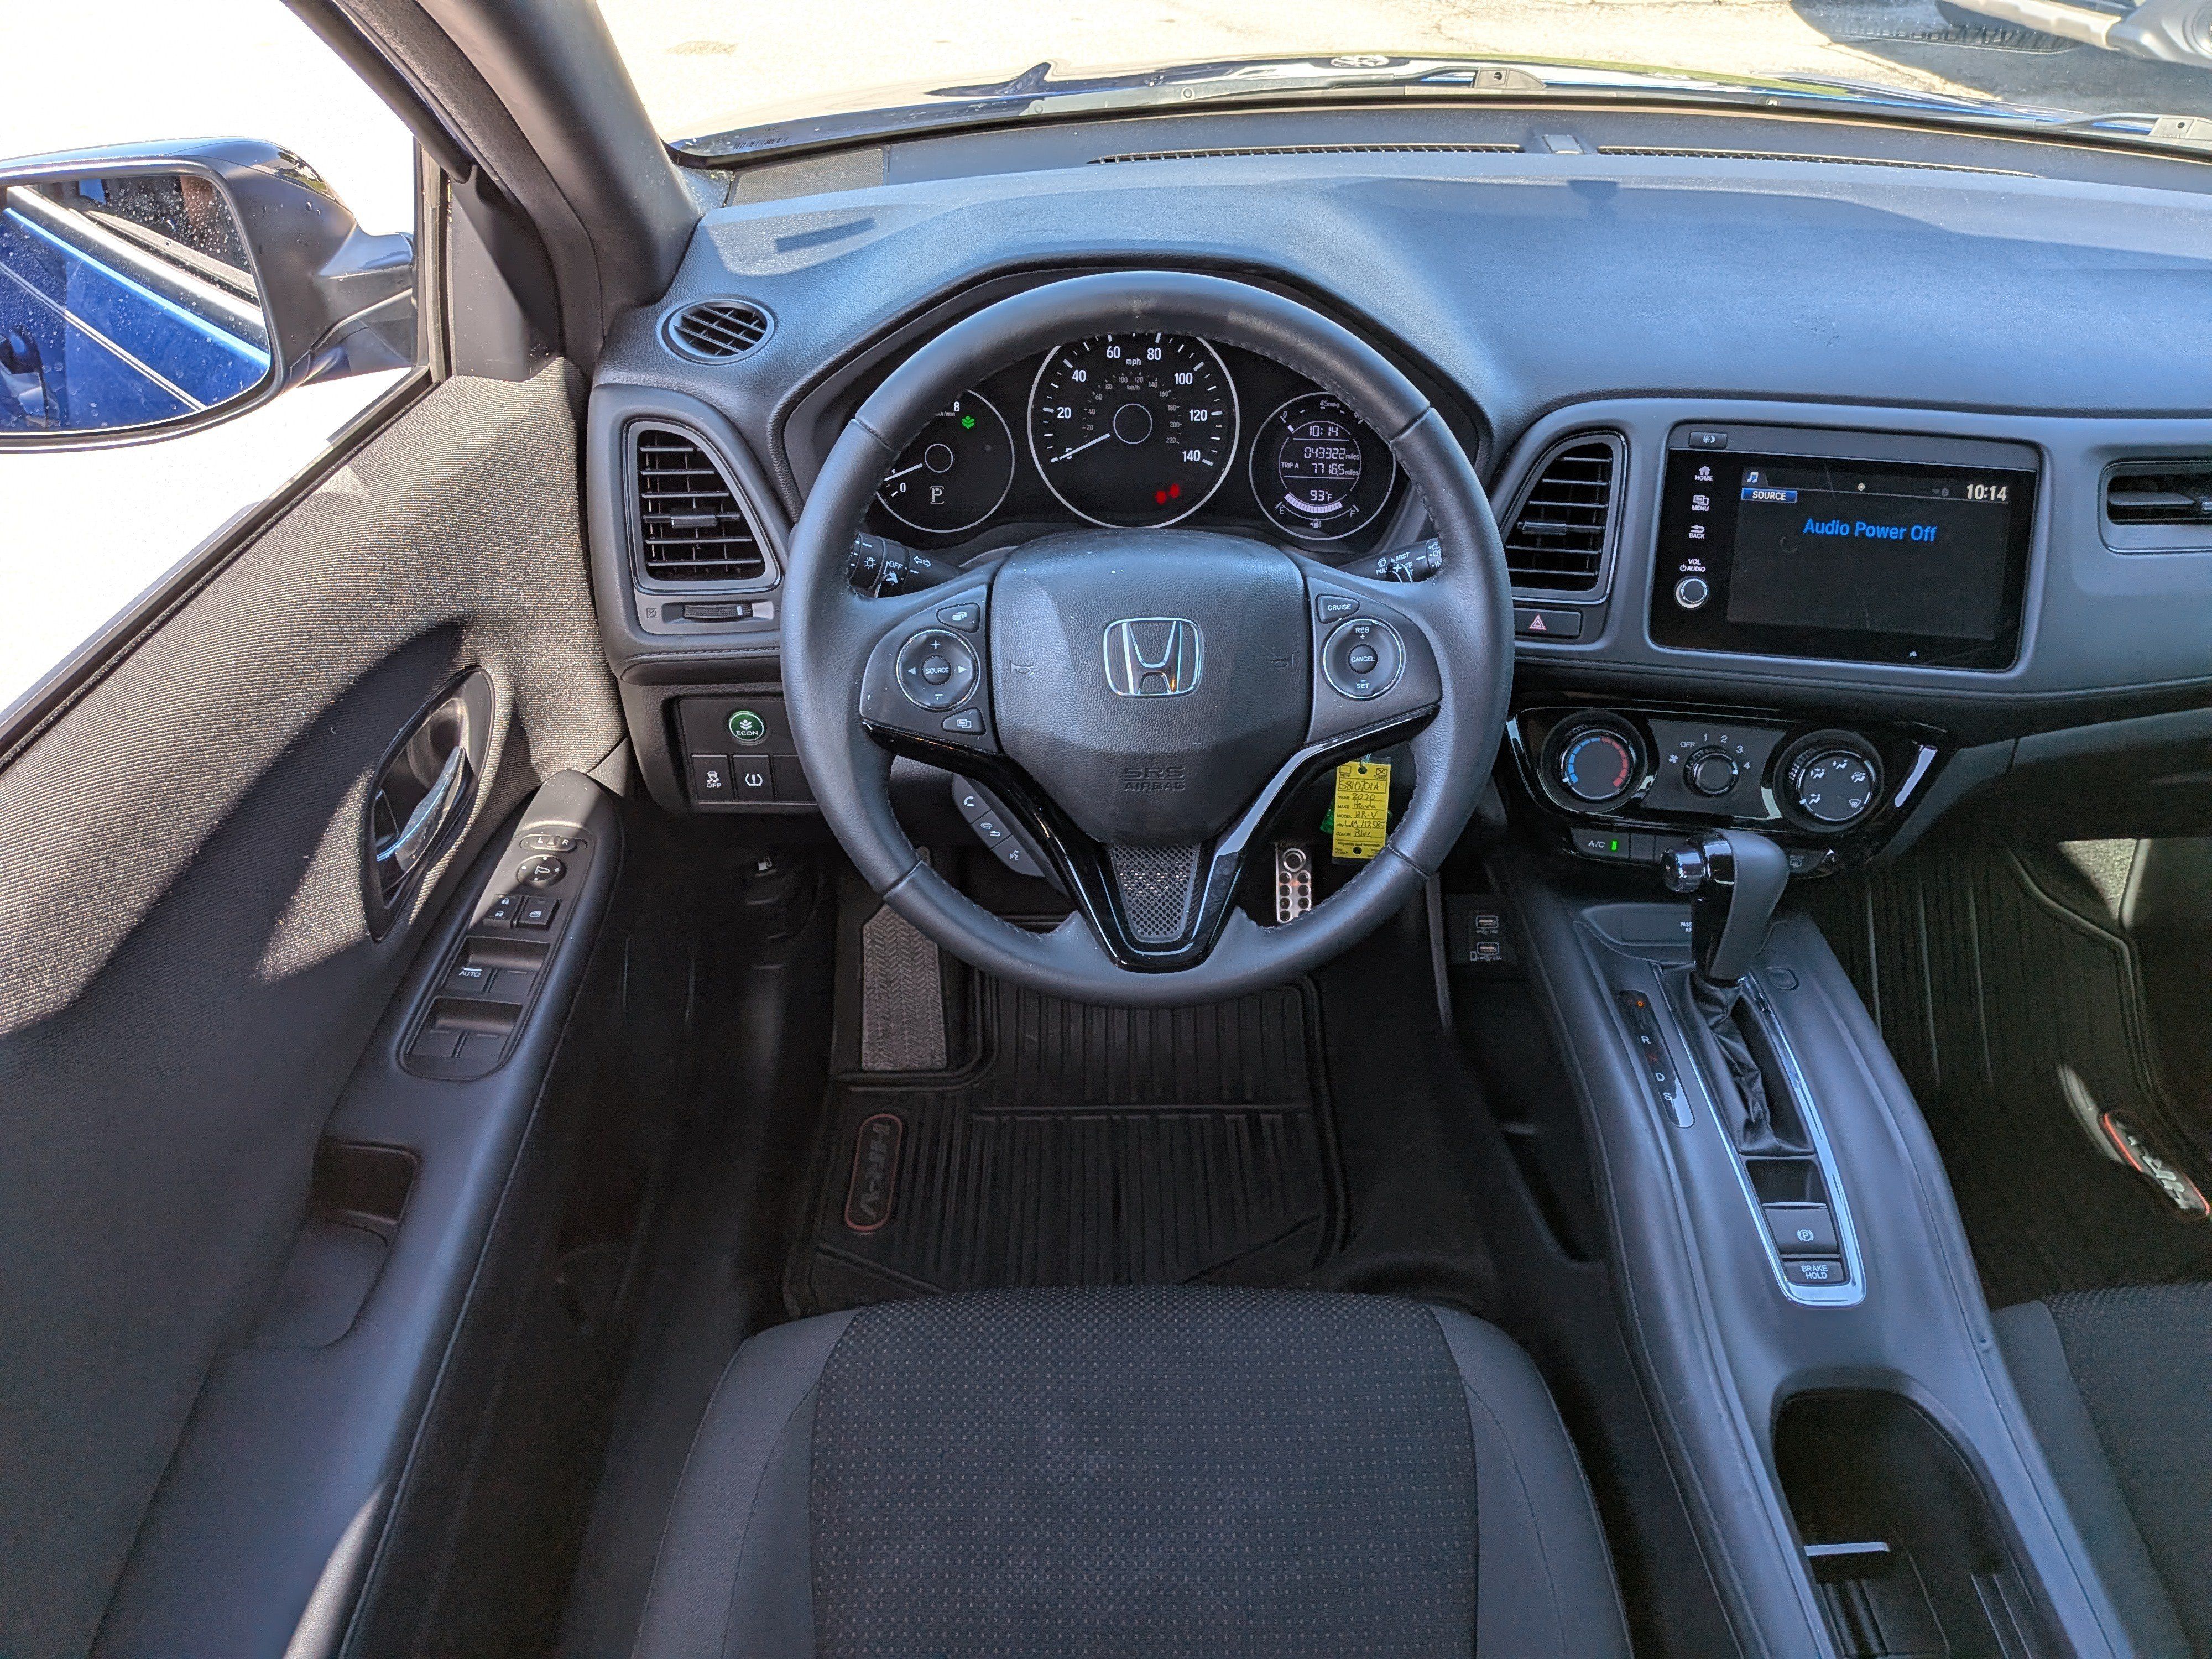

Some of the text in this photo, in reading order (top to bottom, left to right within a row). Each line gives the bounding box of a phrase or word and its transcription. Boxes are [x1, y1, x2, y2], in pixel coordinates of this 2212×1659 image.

[1106, 346, 1121, 358] 60
[1147, 348, 1161, 360] 80
[1126, 358, 1141, 367] mph
[1072, 369, 1086, 382] 40
[1175, 372, 1193, 385] 100
[953, 401, 960, 412] 8
[1057, 406, 1071, 419] 20
[1189, 409, 1208, 421] 120
[1182, 450, 1201, 462] 140
[1304, 447, 1346, 459] 043322
[900, 482, 906, 492] 0
[931, 487, 943, 503] P
[1752, 491, 1787, 501] SOURCE
[1966, 484, 2007, 502] 10:14
[1803, 518, 1938, 543] Audio Power Off
[1396, 552, 1410, 561] MIST
[888, 561, 903, 570] OFF
[1720, 735, 1728, 743] 2
[1124, 766, 1186, 779] SRS
[1124, 781, 1186, 791] AIRBAG
[1588, 839, 1605, 848] A/C
[1641, 1035, 1651, 1044] R
[1655, 1072, 1665, 1082] D
[1663, 1092, 1673, 1101] S
